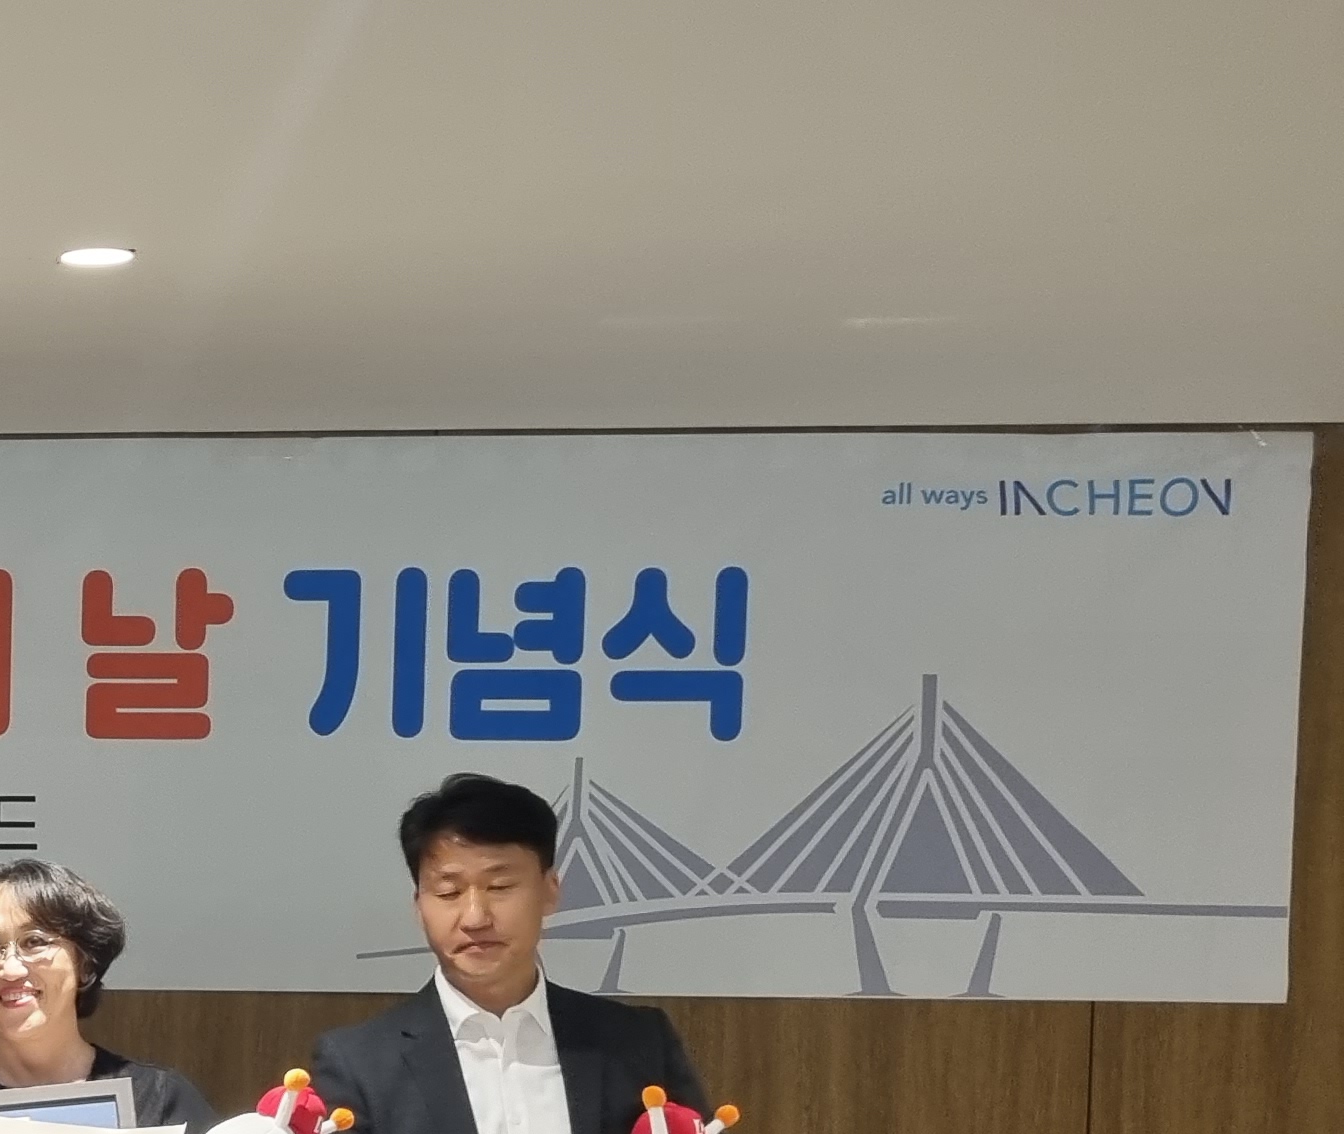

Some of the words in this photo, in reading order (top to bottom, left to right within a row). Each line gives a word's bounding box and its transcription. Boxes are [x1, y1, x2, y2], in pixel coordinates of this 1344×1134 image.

[881, 482, 912, 505] all
[920, 489, 989, 511] ways
[998, 477, 1233, 517] INCHEON
[81, 567, 234, 740] 날
[284, 567, 749, 741] 기념식
